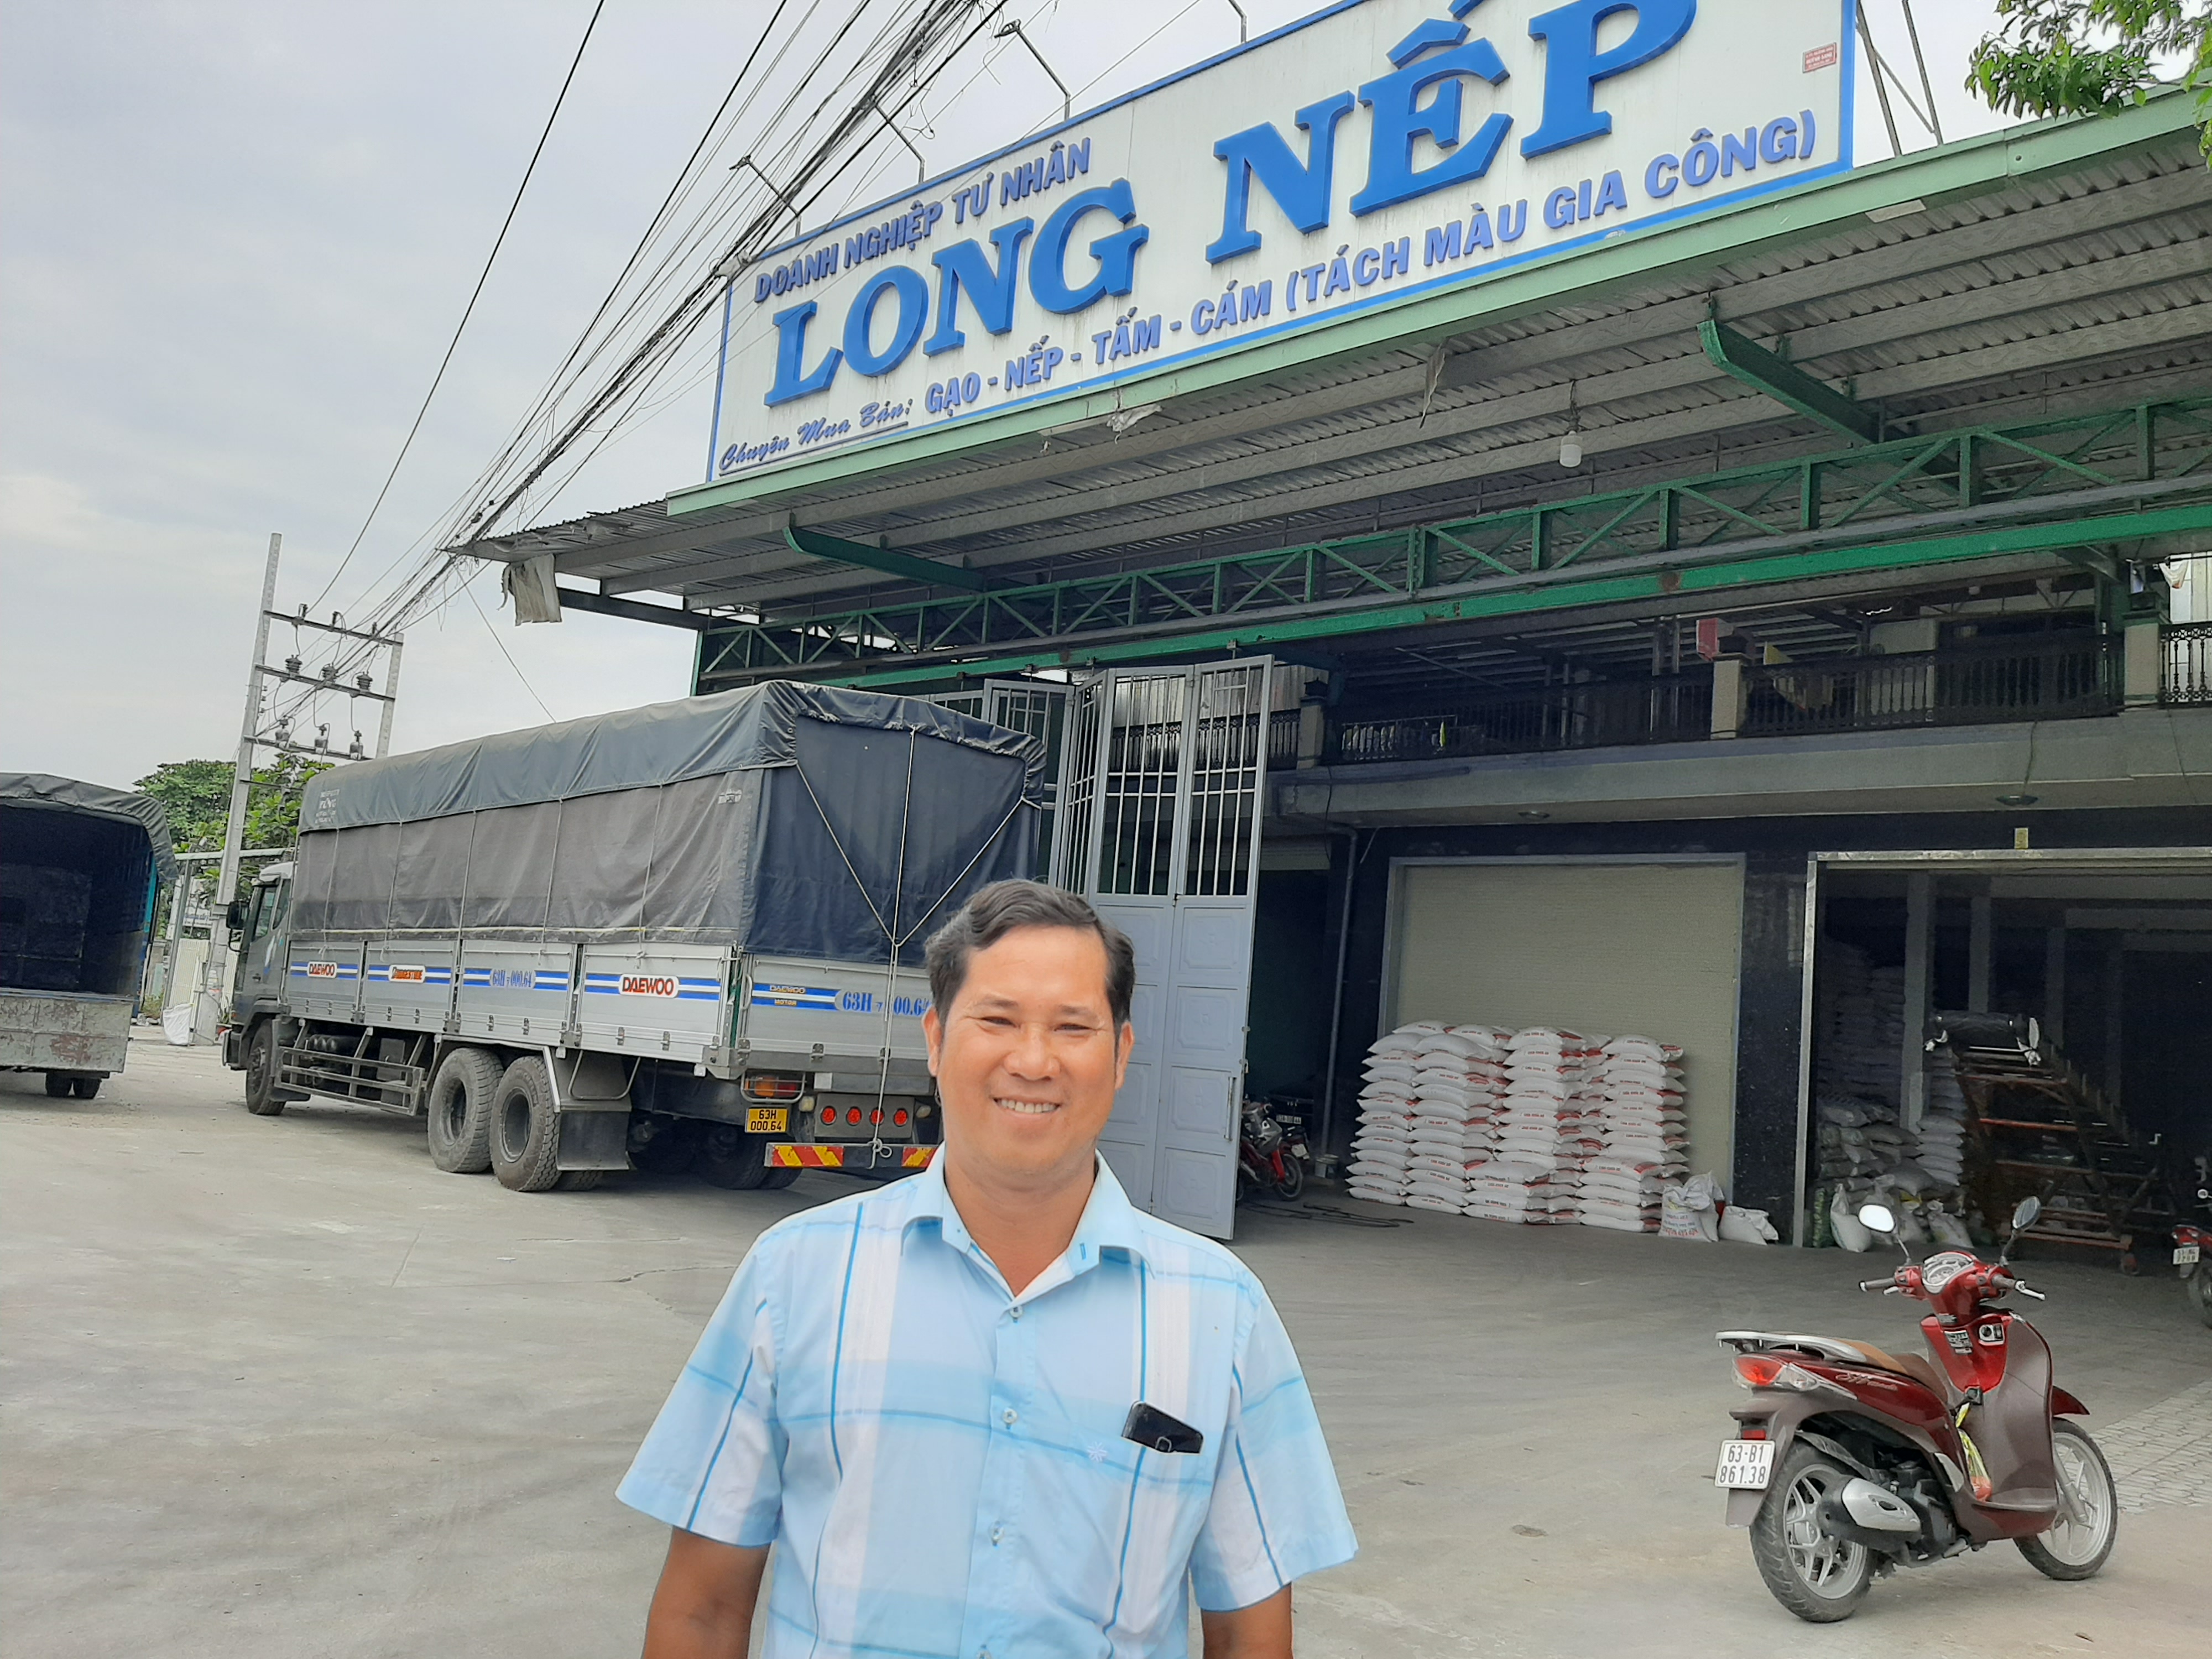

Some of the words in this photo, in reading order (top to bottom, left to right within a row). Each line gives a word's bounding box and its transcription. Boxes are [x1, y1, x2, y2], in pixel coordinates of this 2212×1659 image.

[764, 177, 1150, 408] LONG
[1206, 0, 1697, 264] NẾP
[754, 243, 839, 303] DOANH
[844, 200, 942, 269] NGHIỆP
[951, 171, 994, 224] TƯ
[999, 137, 1091, 206] NHÂN
[718, 436, 790, 471] Chuyên
[797, 417, 852, 445] Mua
[859, 398, 913, 427] Bán:
[925, 372, 982, 416] GẠO
[1004, 335, 1065, 391] NẾP
[1091, 306, 1162, 364] TẤM
[1191, 279, 1272, 336] CÁM
[1286, 244, 1411, 311] (TÁCH
[1423, 199, 1528, 267] MÀU
[1543, 170, 1627, 229] GIA
[1644, 109, 1817, 200] CÔNG)
[309, 963, 335, 977] DAEWOO
[622, 977, 675, 996] DAEWOO
[842, 991, 873, 1014] 63H
[759, 1109, 776, 1120] 63H
[750, 1120, 781, 1131] 000.64
[1728, 1444, 1764, 1463] 63-B1
[1719, 1465, 1766, 1484] 861.38
